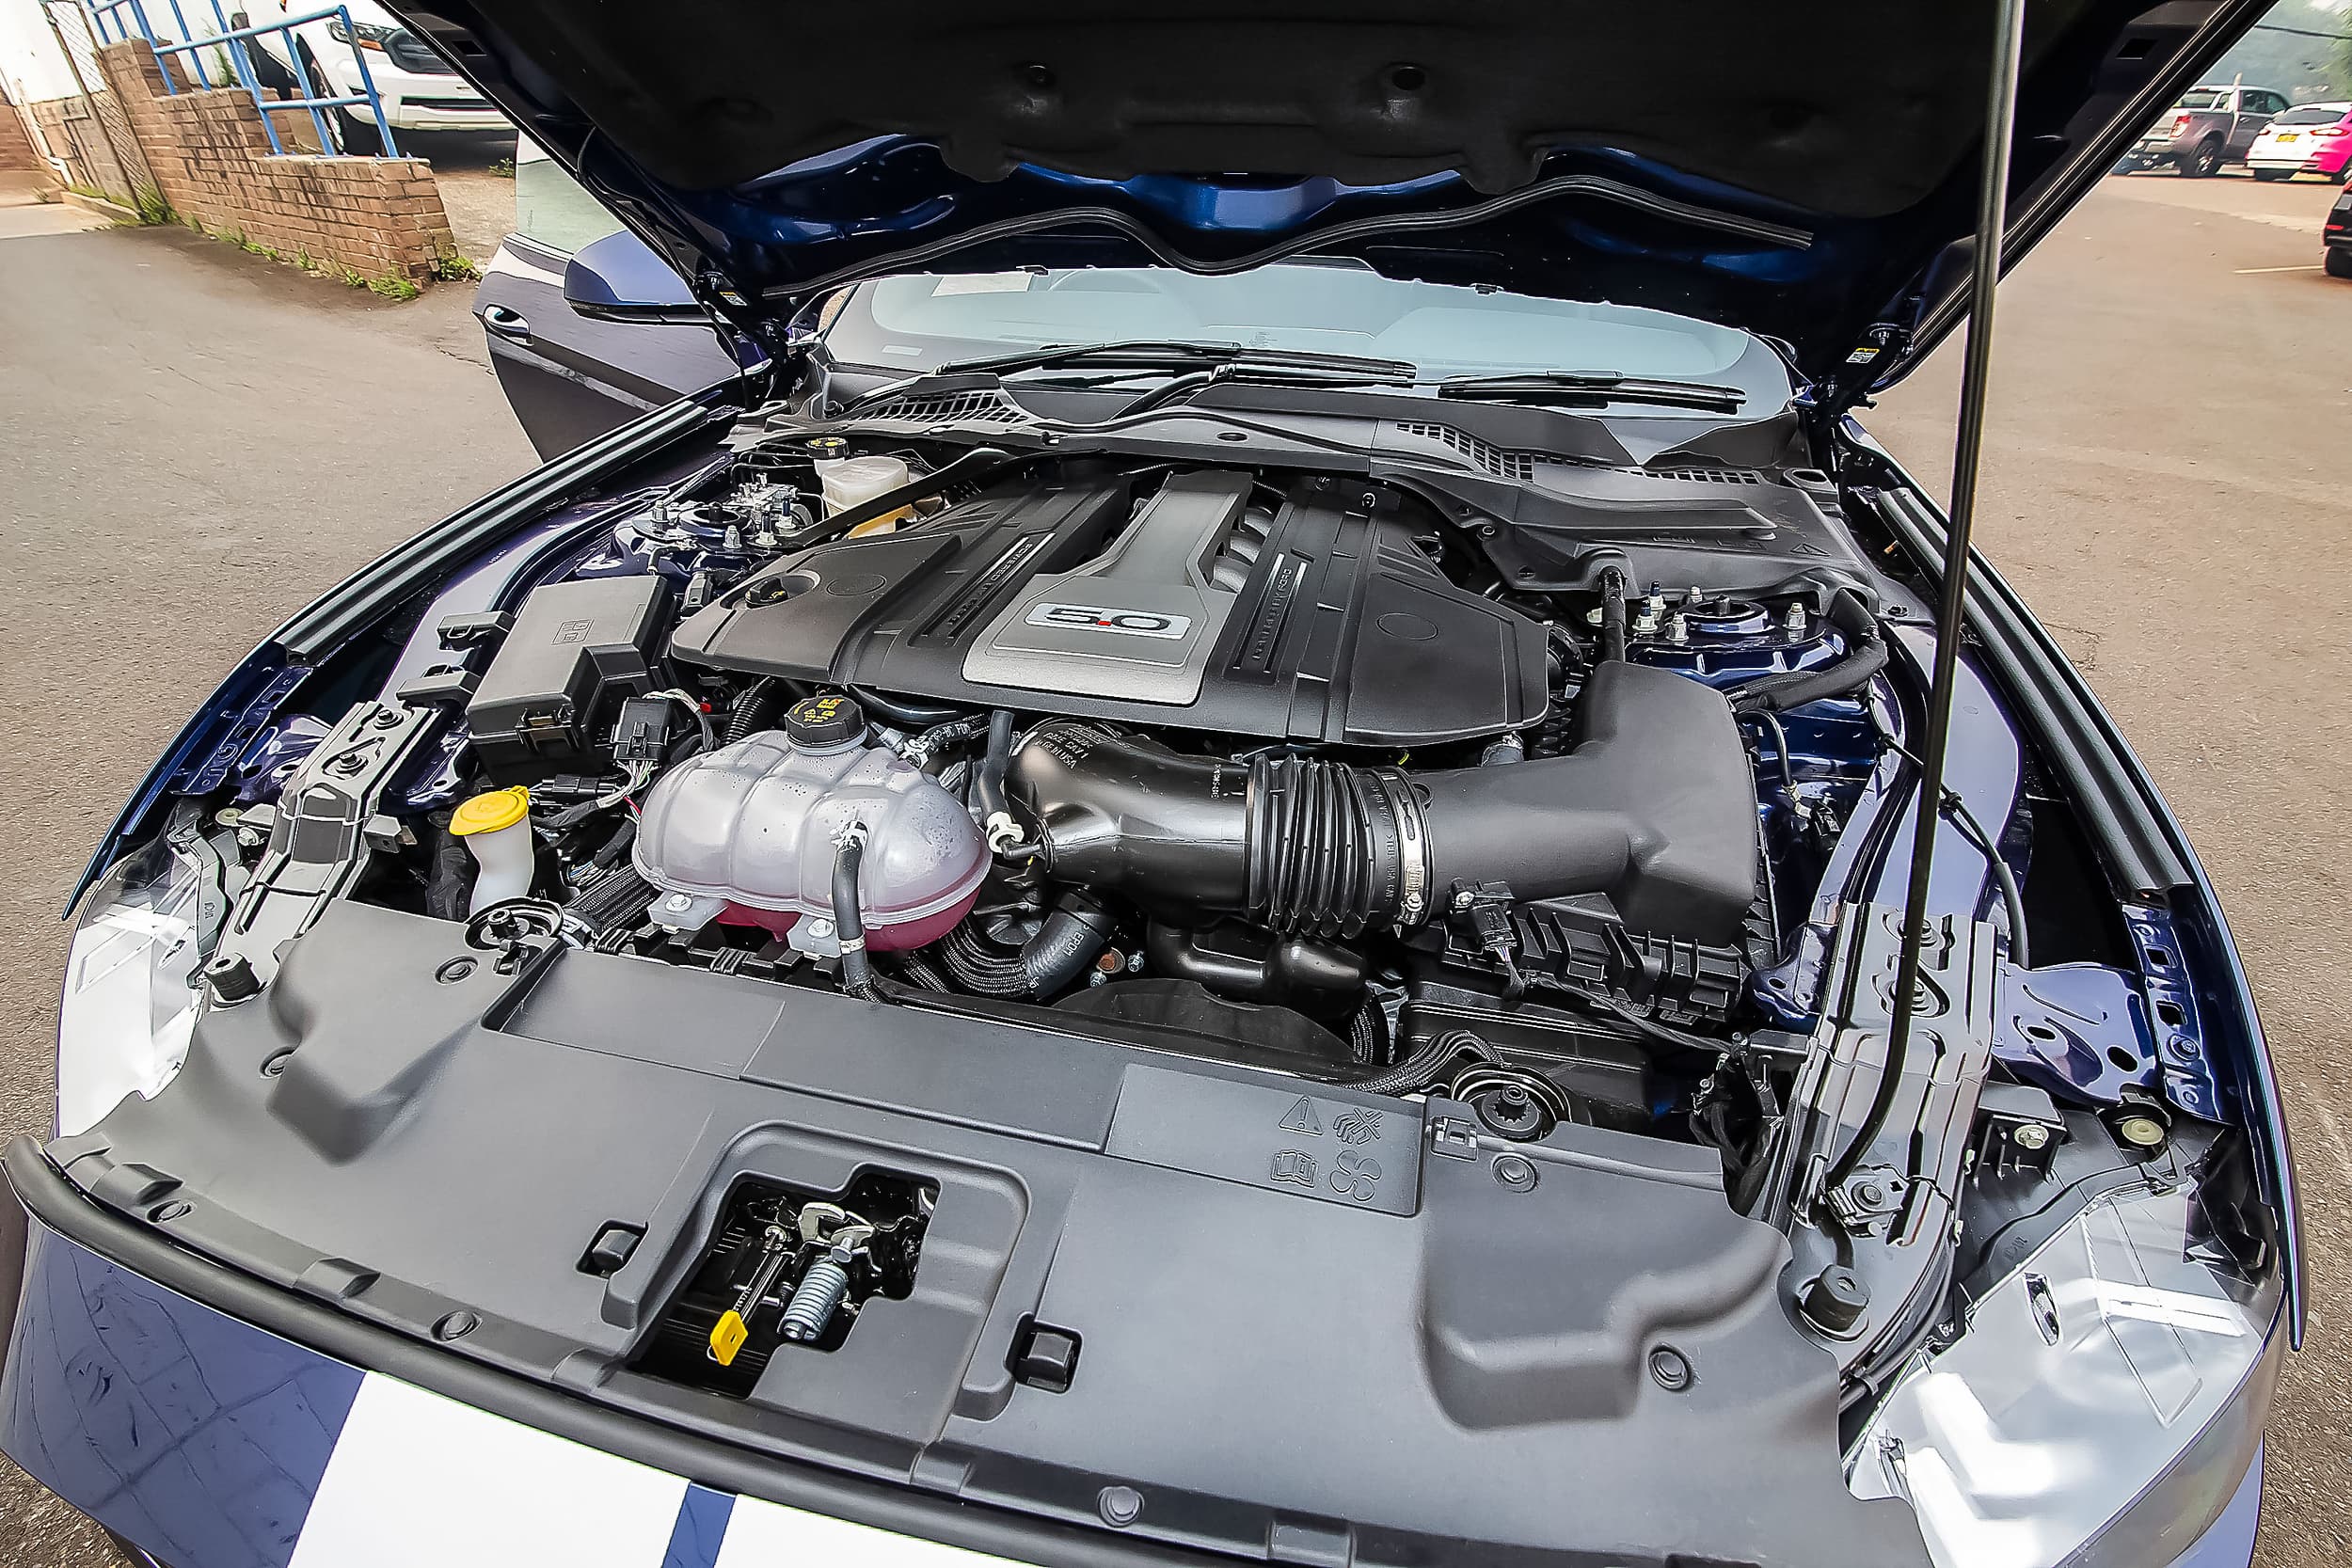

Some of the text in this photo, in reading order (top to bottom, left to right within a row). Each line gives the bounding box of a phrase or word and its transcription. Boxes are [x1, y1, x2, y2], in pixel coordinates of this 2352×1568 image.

[1044, 607, 1173, 632] 5.0
[1058, 752, 1077, 769] USA
[1062, 931, 1085, 957] EPDM
